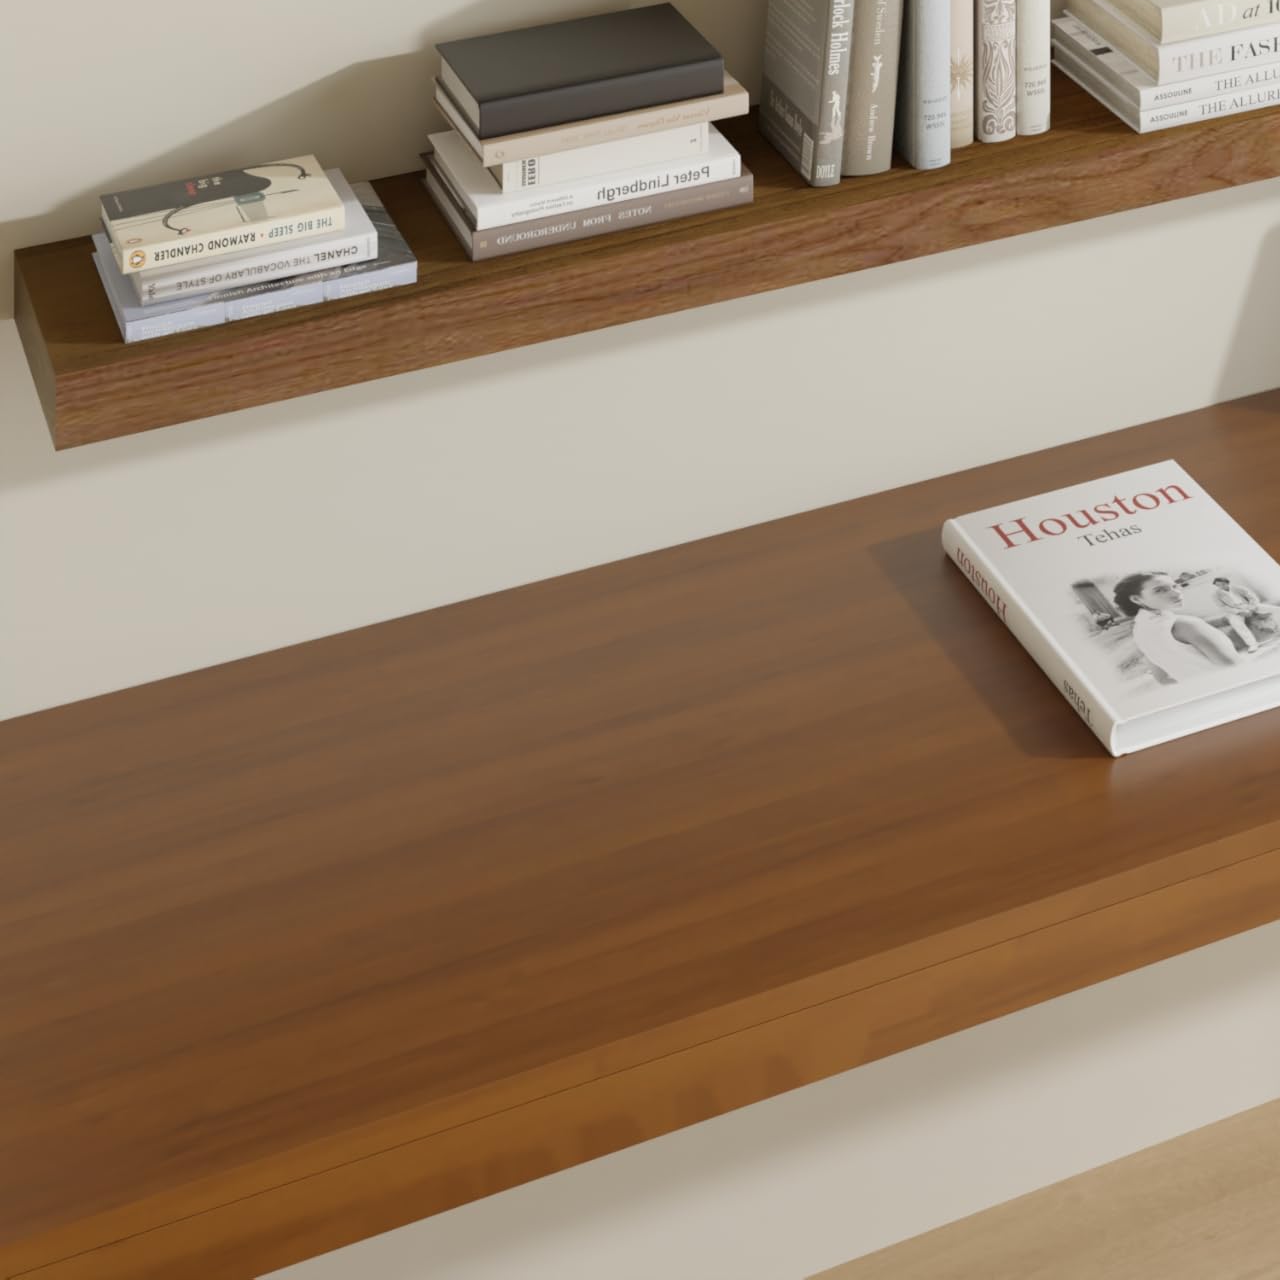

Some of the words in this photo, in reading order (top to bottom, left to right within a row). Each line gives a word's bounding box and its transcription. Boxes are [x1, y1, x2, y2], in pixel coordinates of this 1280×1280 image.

[1242, 5, 1260, 20] at
[827, 32, 849, 76] Holmes
[1172, 46, 1223, 72] THE
[1215, 76, 1242, 91] THE
[1154, 87, 1192, 100] ASSOULINE
[1151, 110, 1188, 122] ASSOULINE
[1200, 101, 1227, 116] THE
[298, 220, 313, 232] BIG
[315, 216, 332, 228] THE
[268, 223, 295, 239] SLEEP
[208, 231, 255, 250] RAYMOND
[154, 243, 205, 262] CHANDLER
[314, 245, 358, 261] CHANEL
[290, 256, 311, 266] THE
[208, 272, 223, 283] OF
[225, 259, 290, 281] VOCABULARY
[176, 275, 206, 290] STYLE
[987, 482, 1192, 551] Houston
[1077, 524, 1142, 549] Tehas
[955, 546, 1008, 621] Houston
